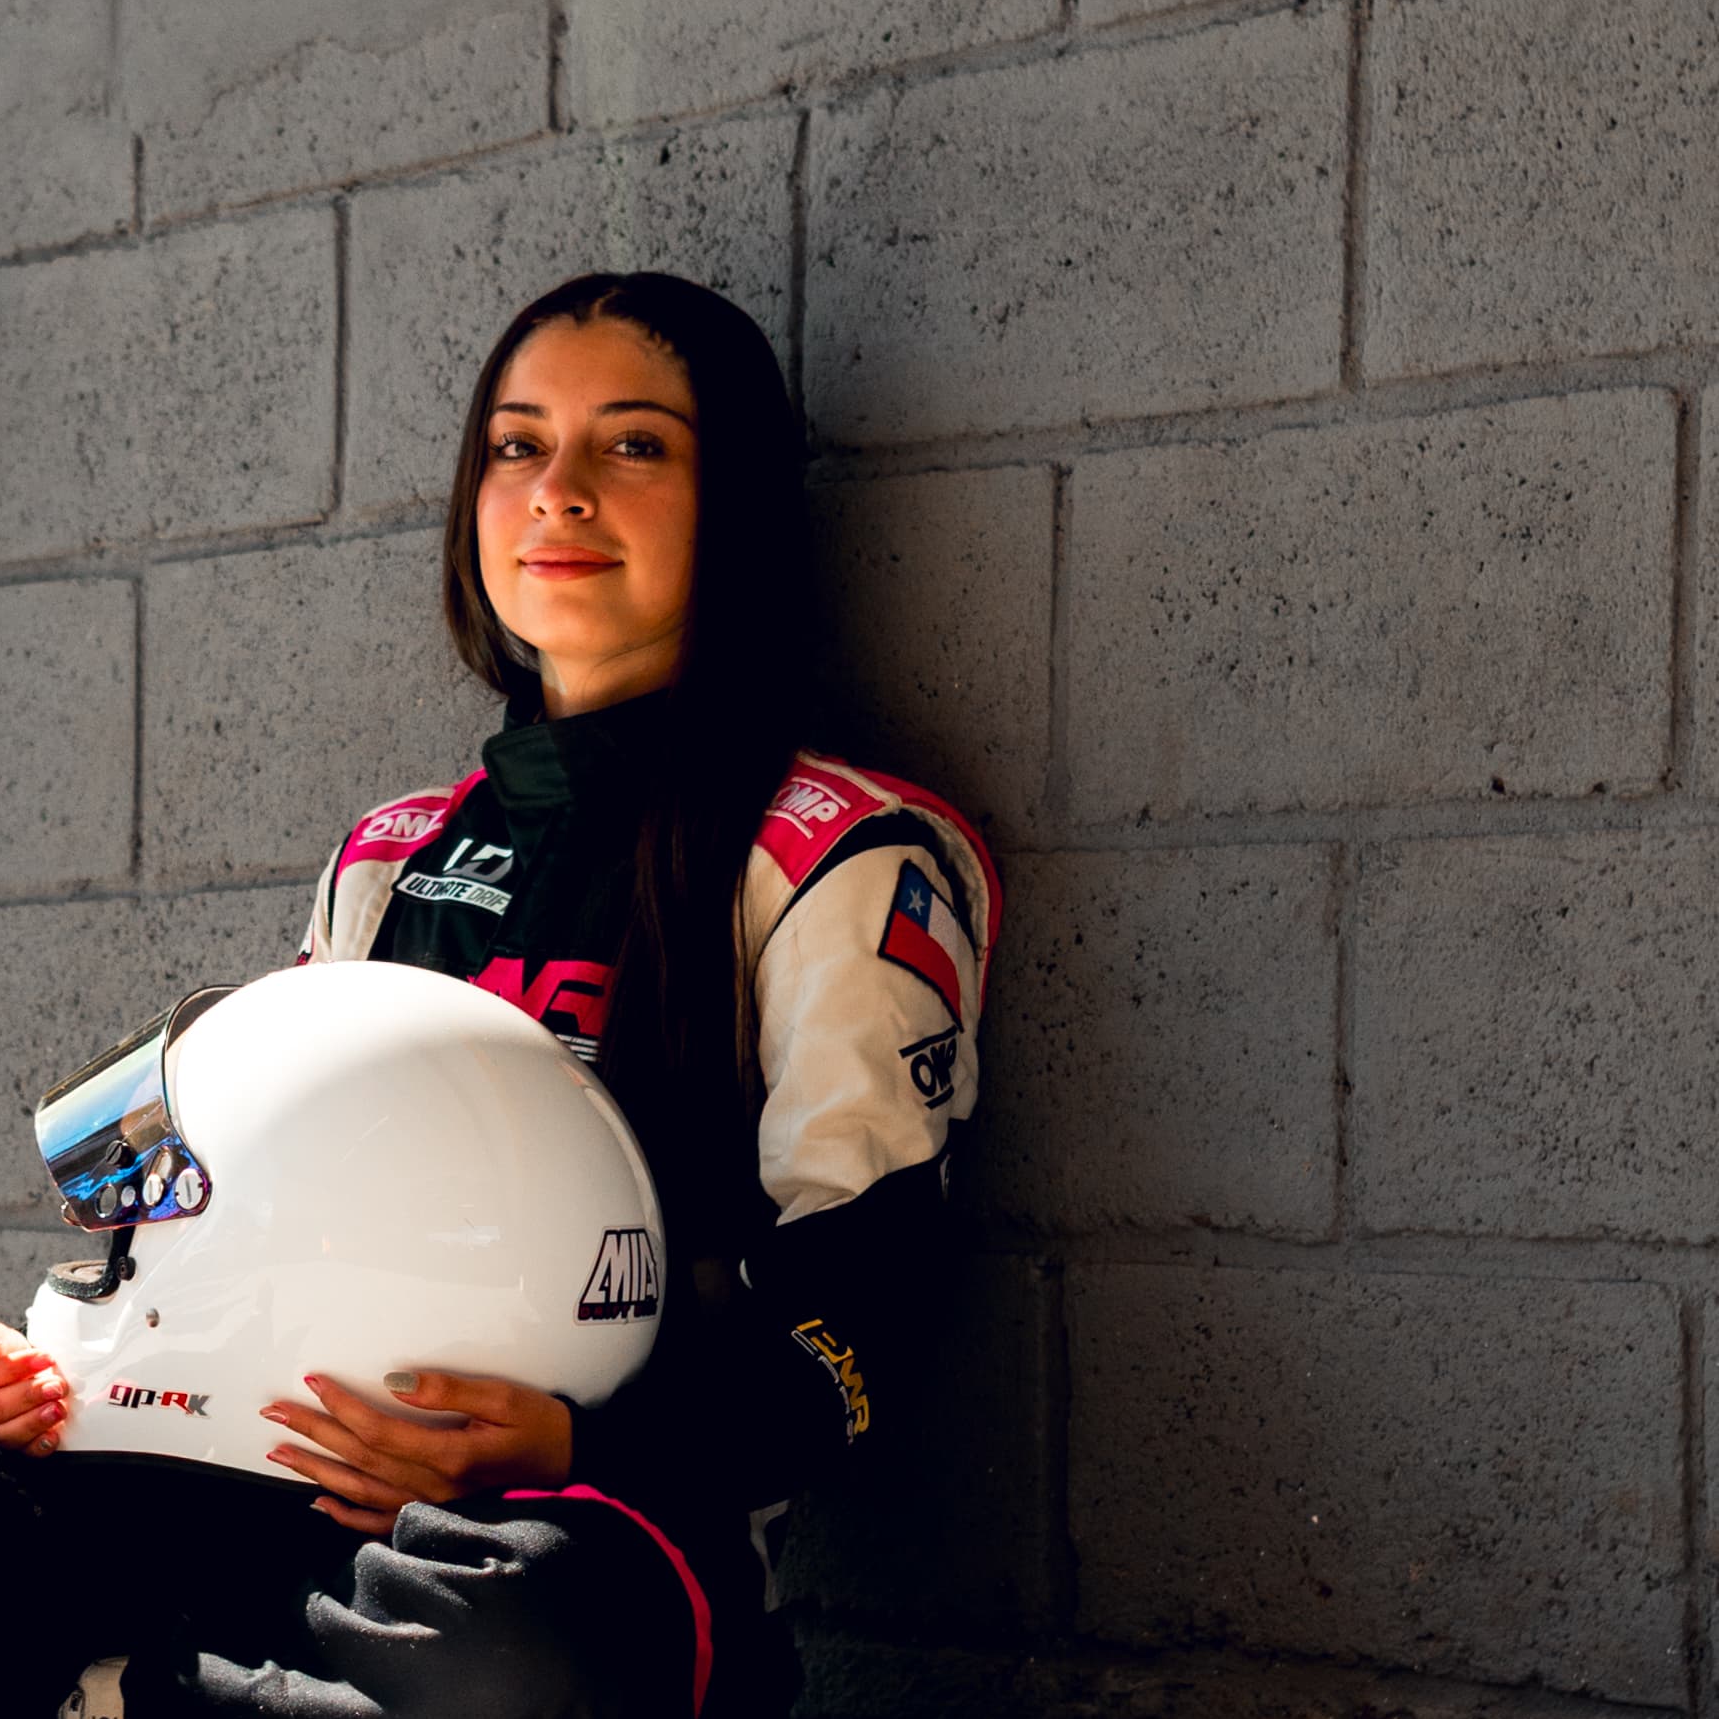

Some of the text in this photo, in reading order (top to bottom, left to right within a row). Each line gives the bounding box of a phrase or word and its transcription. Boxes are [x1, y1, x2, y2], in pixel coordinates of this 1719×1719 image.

[769, 782, 839, 823] OMP
[910, 1038, 957, 1098] OMP
[580, 1229, 659, 1303] MIA
